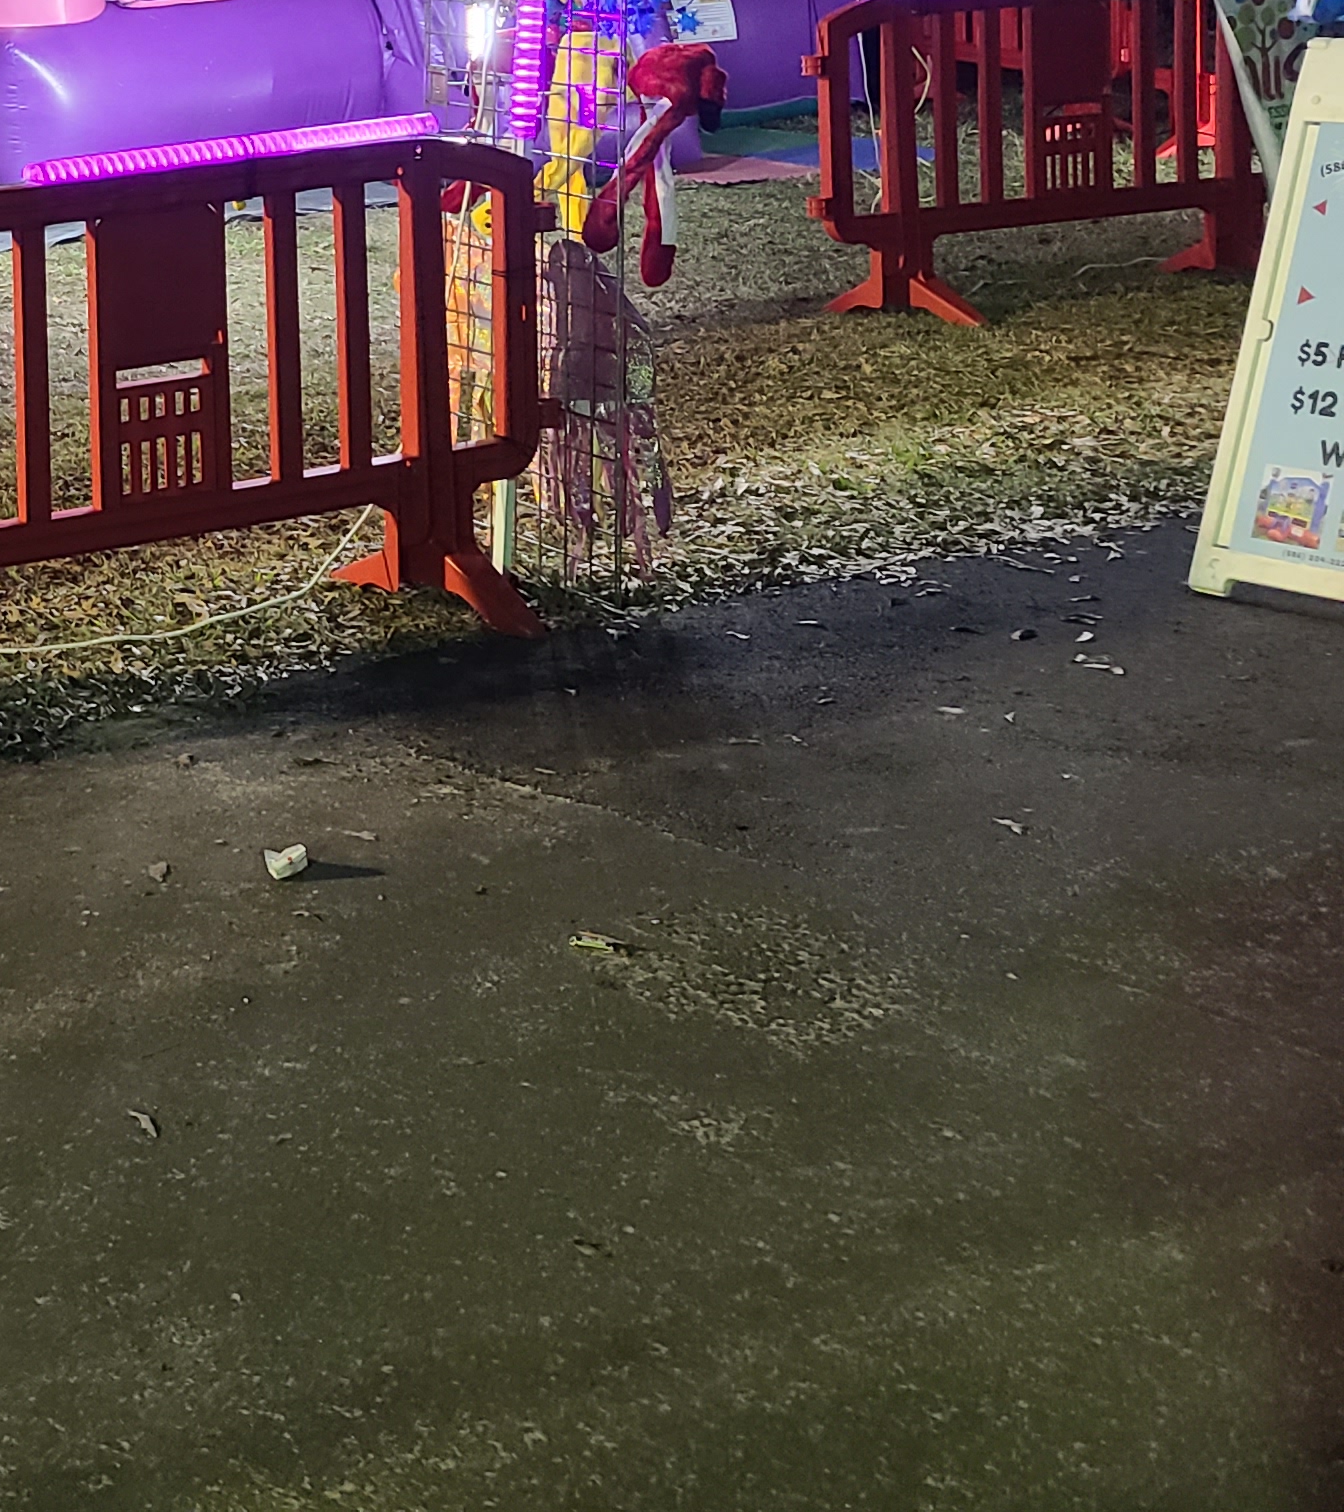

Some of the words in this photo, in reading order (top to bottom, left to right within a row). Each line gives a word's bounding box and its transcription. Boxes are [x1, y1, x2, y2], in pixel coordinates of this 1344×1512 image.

[1320, 160, 1344, 178] (58
[1297, 339, 1329, 367] $5
[1290, 386, 1338, 418] $12
